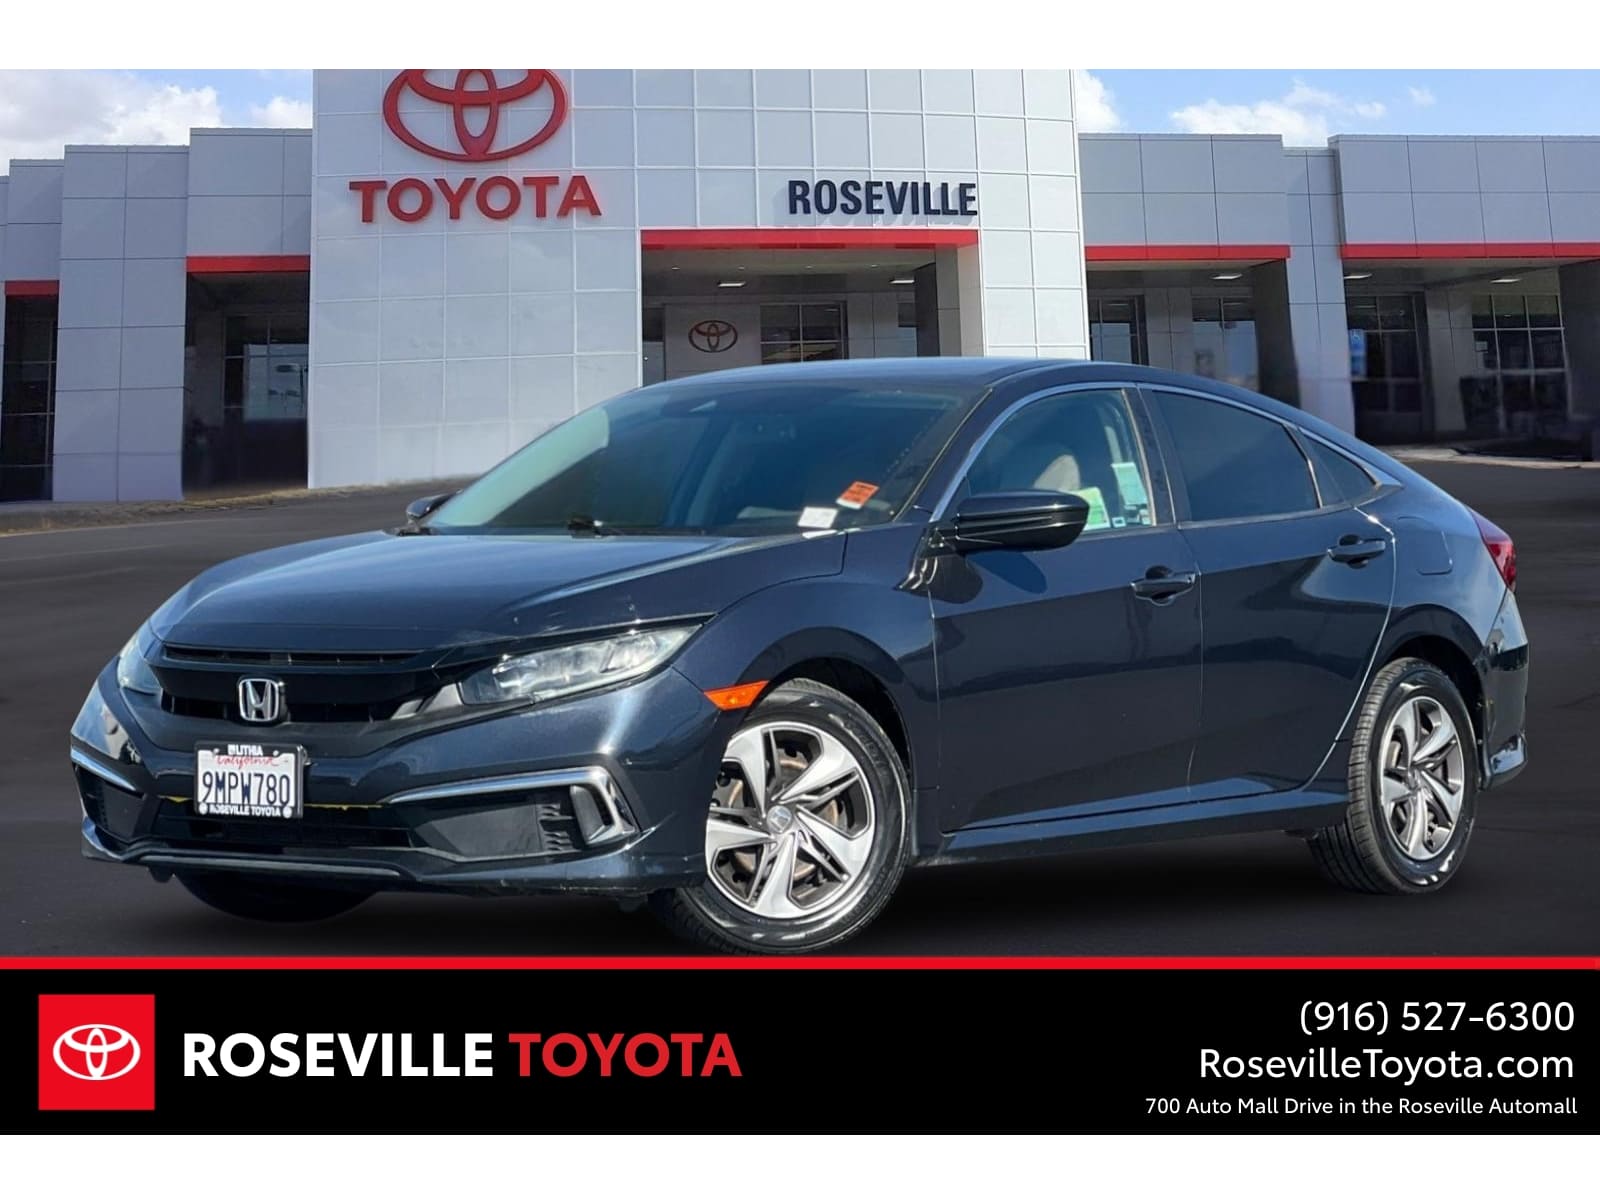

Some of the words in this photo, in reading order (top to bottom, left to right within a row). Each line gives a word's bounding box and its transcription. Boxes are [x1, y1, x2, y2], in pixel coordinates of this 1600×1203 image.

[349, 175, 602, 223] TOYOTA
[788, 179, 978, 216] ROSEVILLE
[202, 771, 290, 806] 9MPW780
[209, 803, 250, 816] ROSEVILLE
[251, 806, 281, 817] TOYOTA
